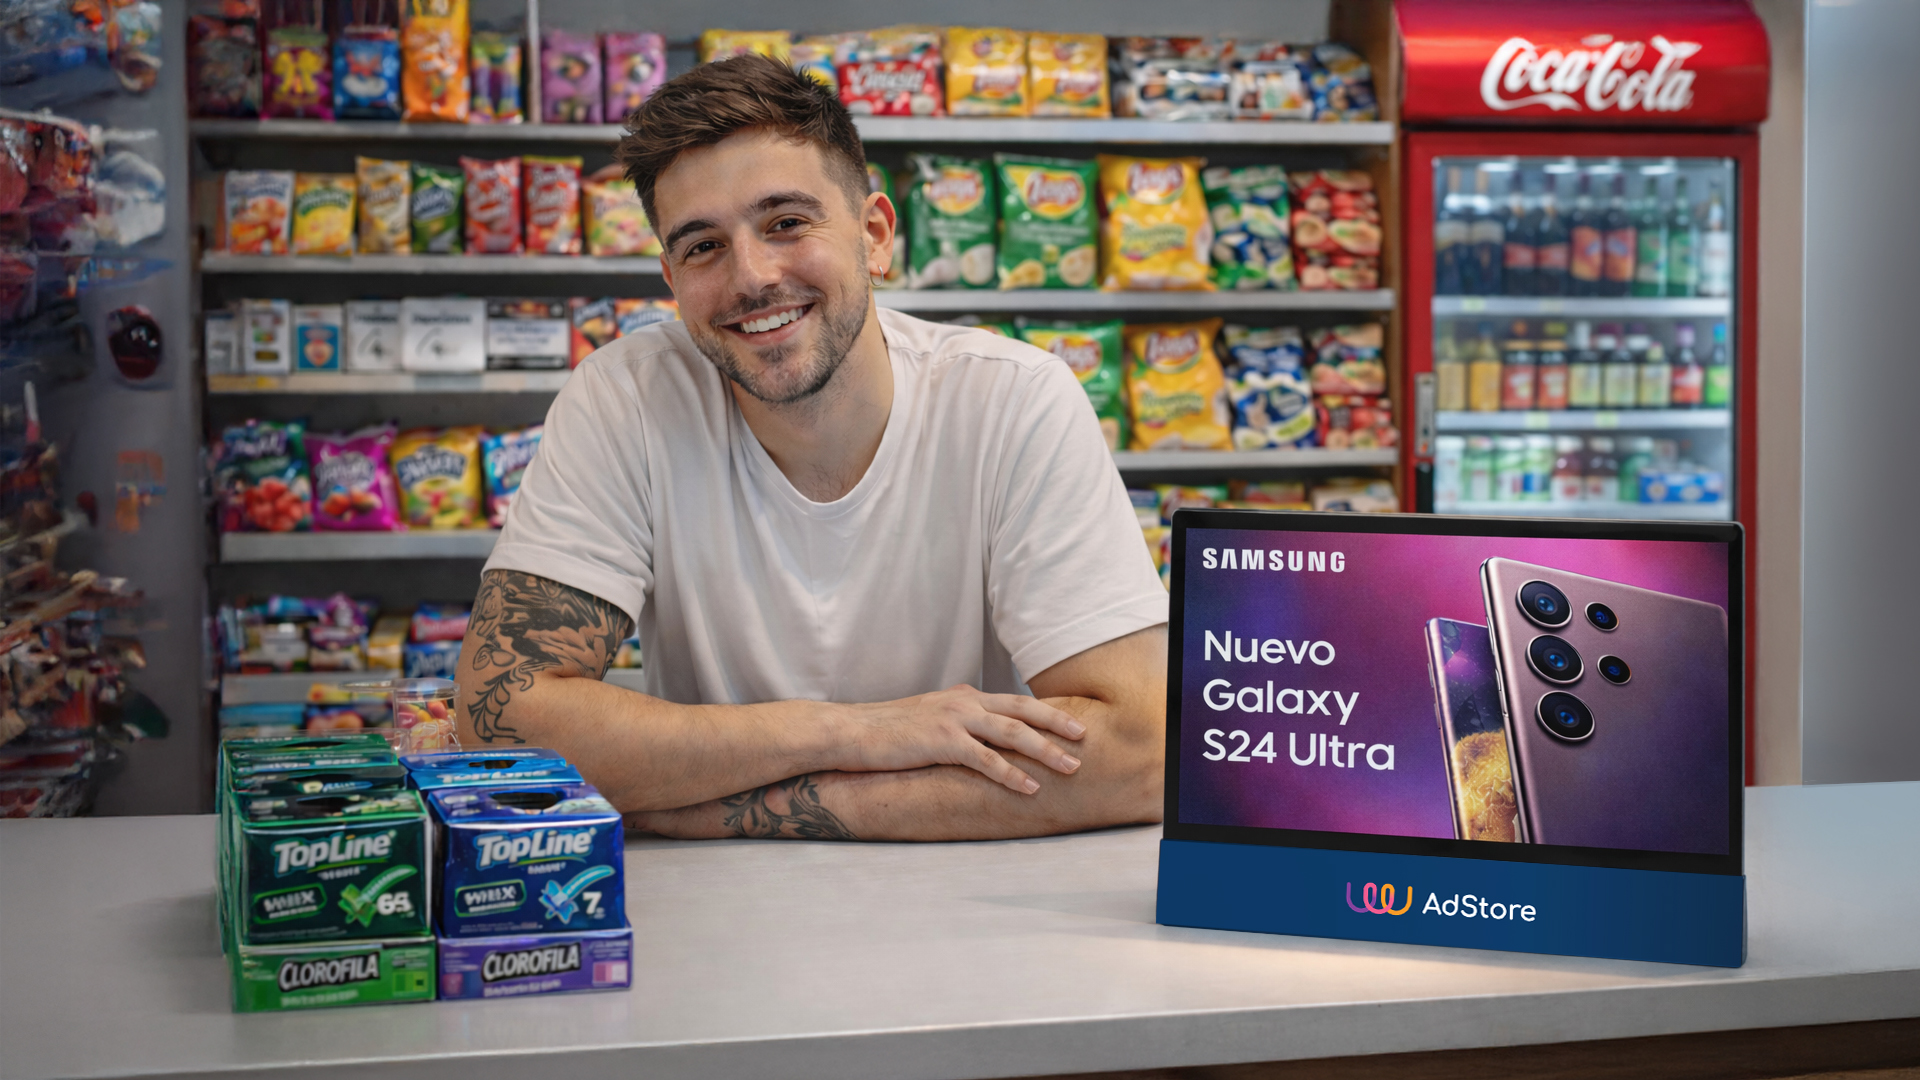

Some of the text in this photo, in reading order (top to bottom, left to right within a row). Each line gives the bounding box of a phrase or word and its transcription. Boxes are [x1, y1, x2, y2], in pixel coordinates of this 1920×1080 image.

[1202, 547, 1346, 573] SAMSUNG
[1204, 629, 1336, 666] Nuevo
[1202, 678, 1360, 726] Galaxy
[1202, 728, 1395, 771] S24 Ultra
[274, 833, 391, 875] TopLine
[476, 830, 593, 868] TopLine
[582, 891, 603, 915] 7
[1422, 892, 1537, 922] AdStore
[279, 953, 380, 991] CLOROFILA
[483, 944, 580, 981] CLOROFILA
